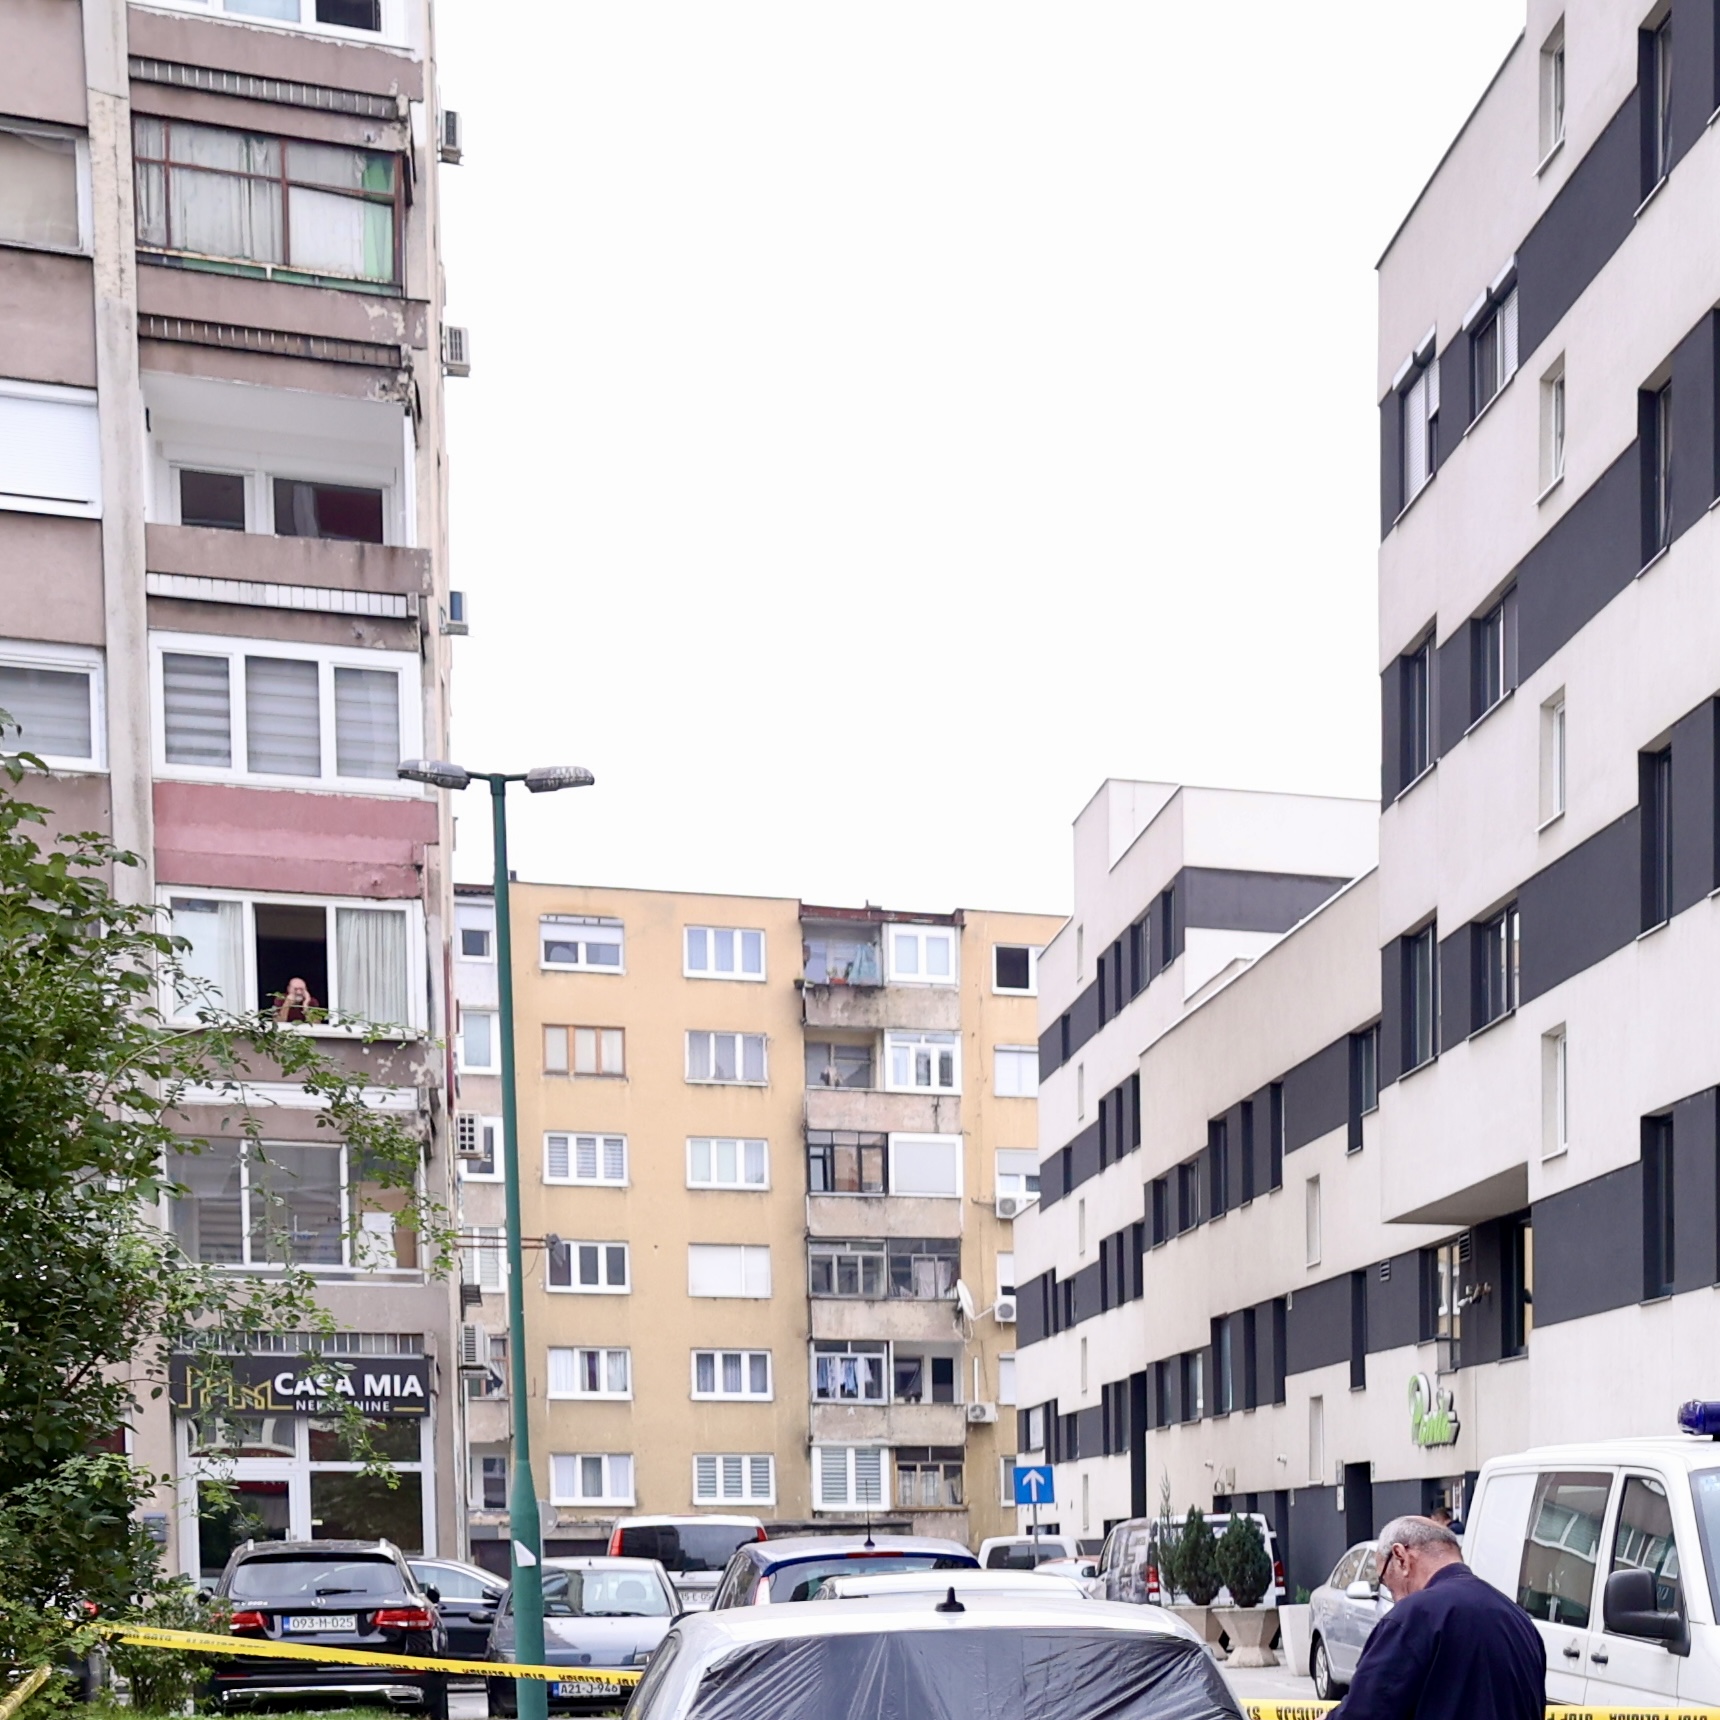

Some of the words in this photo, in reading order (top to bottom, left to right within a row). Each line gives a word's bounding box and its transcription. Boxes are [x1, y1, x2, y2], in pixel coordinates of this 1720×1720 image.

[274, 1372, 355, 1396] CASA
[364, 1374, 424, 1397] MIA
[292, 1617, 354, 1629] 093-M-025
